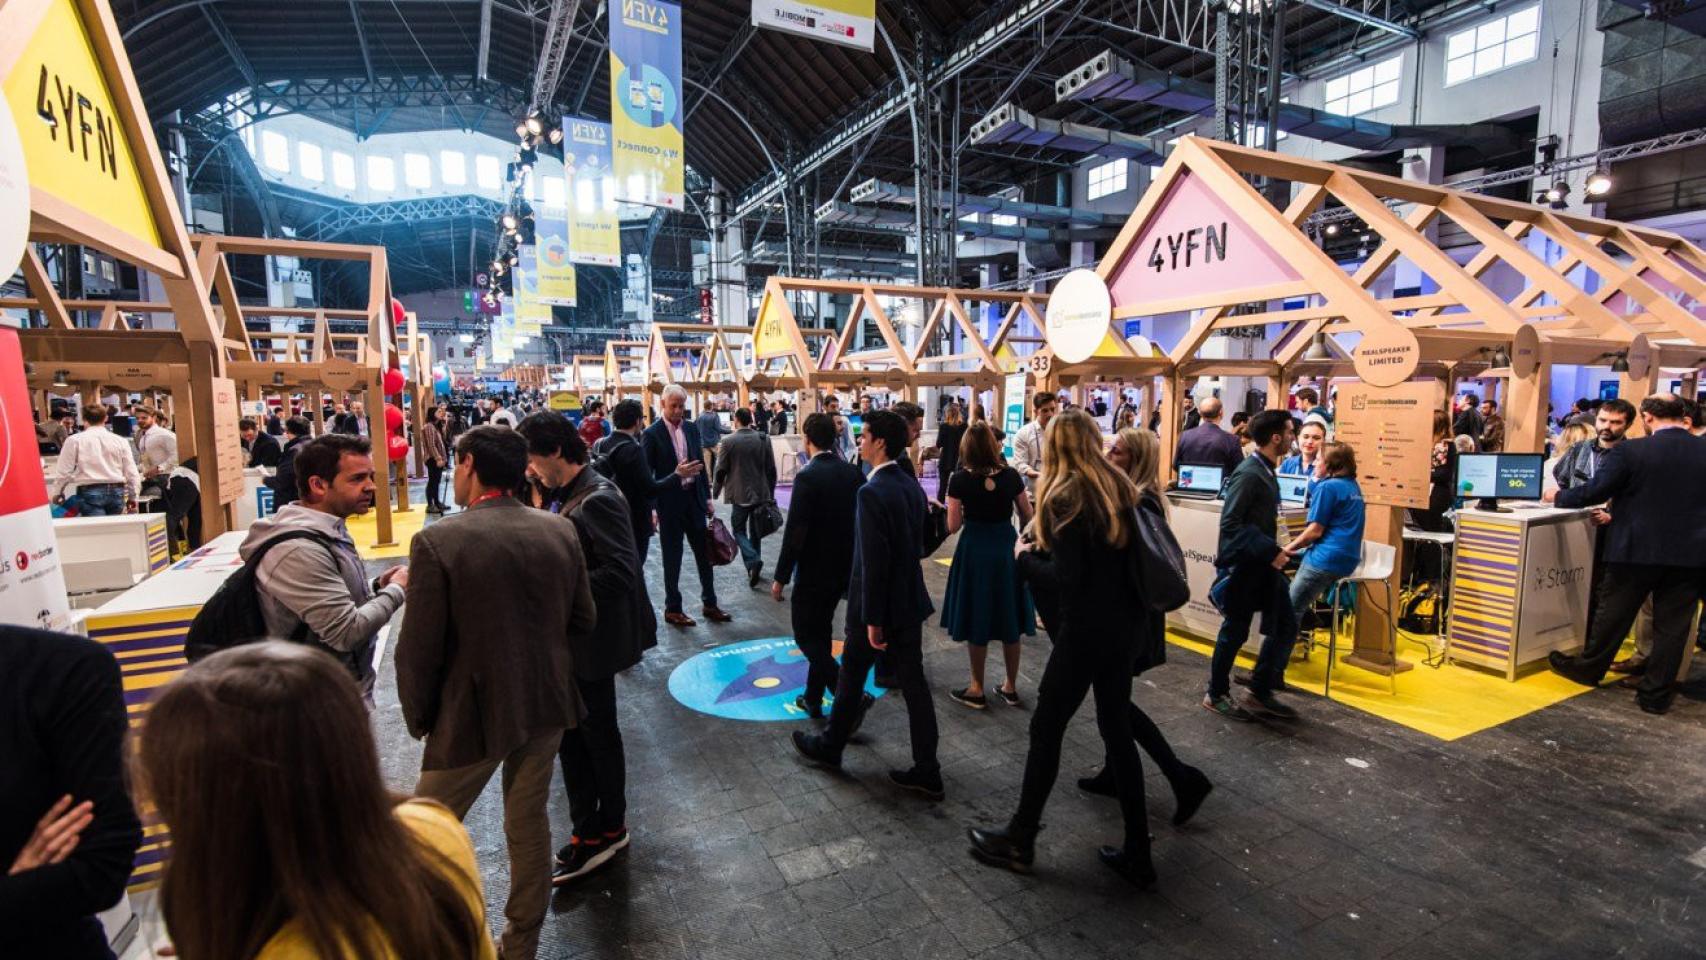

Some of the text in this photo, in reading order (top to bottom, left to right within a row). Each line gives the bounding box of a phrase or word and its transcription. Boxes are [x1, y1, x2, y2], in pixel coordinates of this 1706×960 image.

[37, 63, 118, 181] 4YFN
[1148, 222, 1228, 273] 4YFN
[764, 318, 782, 337] 4YFN
[1361, 346, 1411, 356] REALSPEAKER
[1031, 354, 1048, 370] 33
[1369, 357, 1404, 366] LIMITED
[1547, 566, 1585, 589] Storm
[708, 642, 772, 659] Launch
